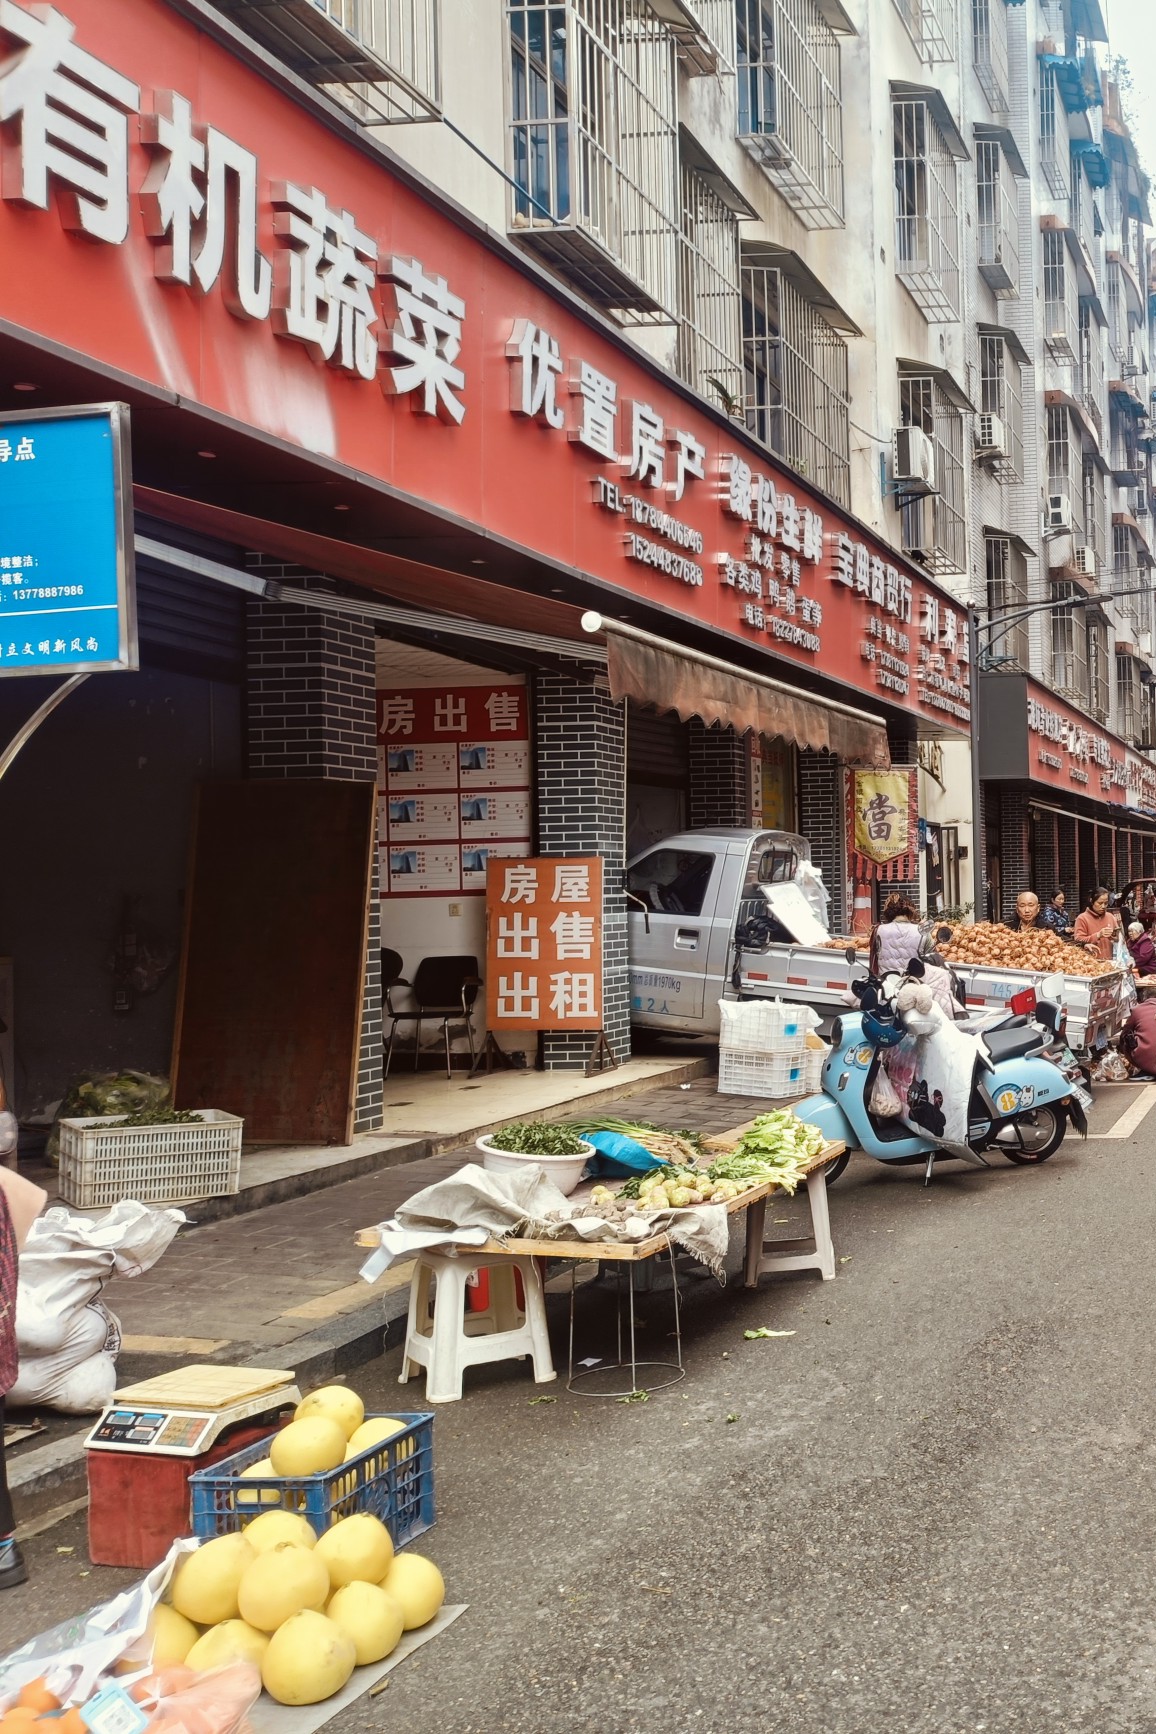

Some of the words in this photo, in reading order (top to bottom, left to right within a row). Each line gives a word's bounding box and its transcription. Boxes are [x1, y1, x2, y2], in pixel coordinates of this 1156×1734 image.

[0, 5, 466, 427] 有机蔬菜
[508, 320, 705, 501] 优置房产
[630, 534, 703, 586] 15244837688
[0, 636, 99, 658] 立文明新风尚
[379, 691, 520, 735] 房出售
[862, 792, 897, 841] 當
[500, 864, 593, 905] 房屋
[496, 910, 595, 961] 出售
[496, 970, 599, 1020] 出租
